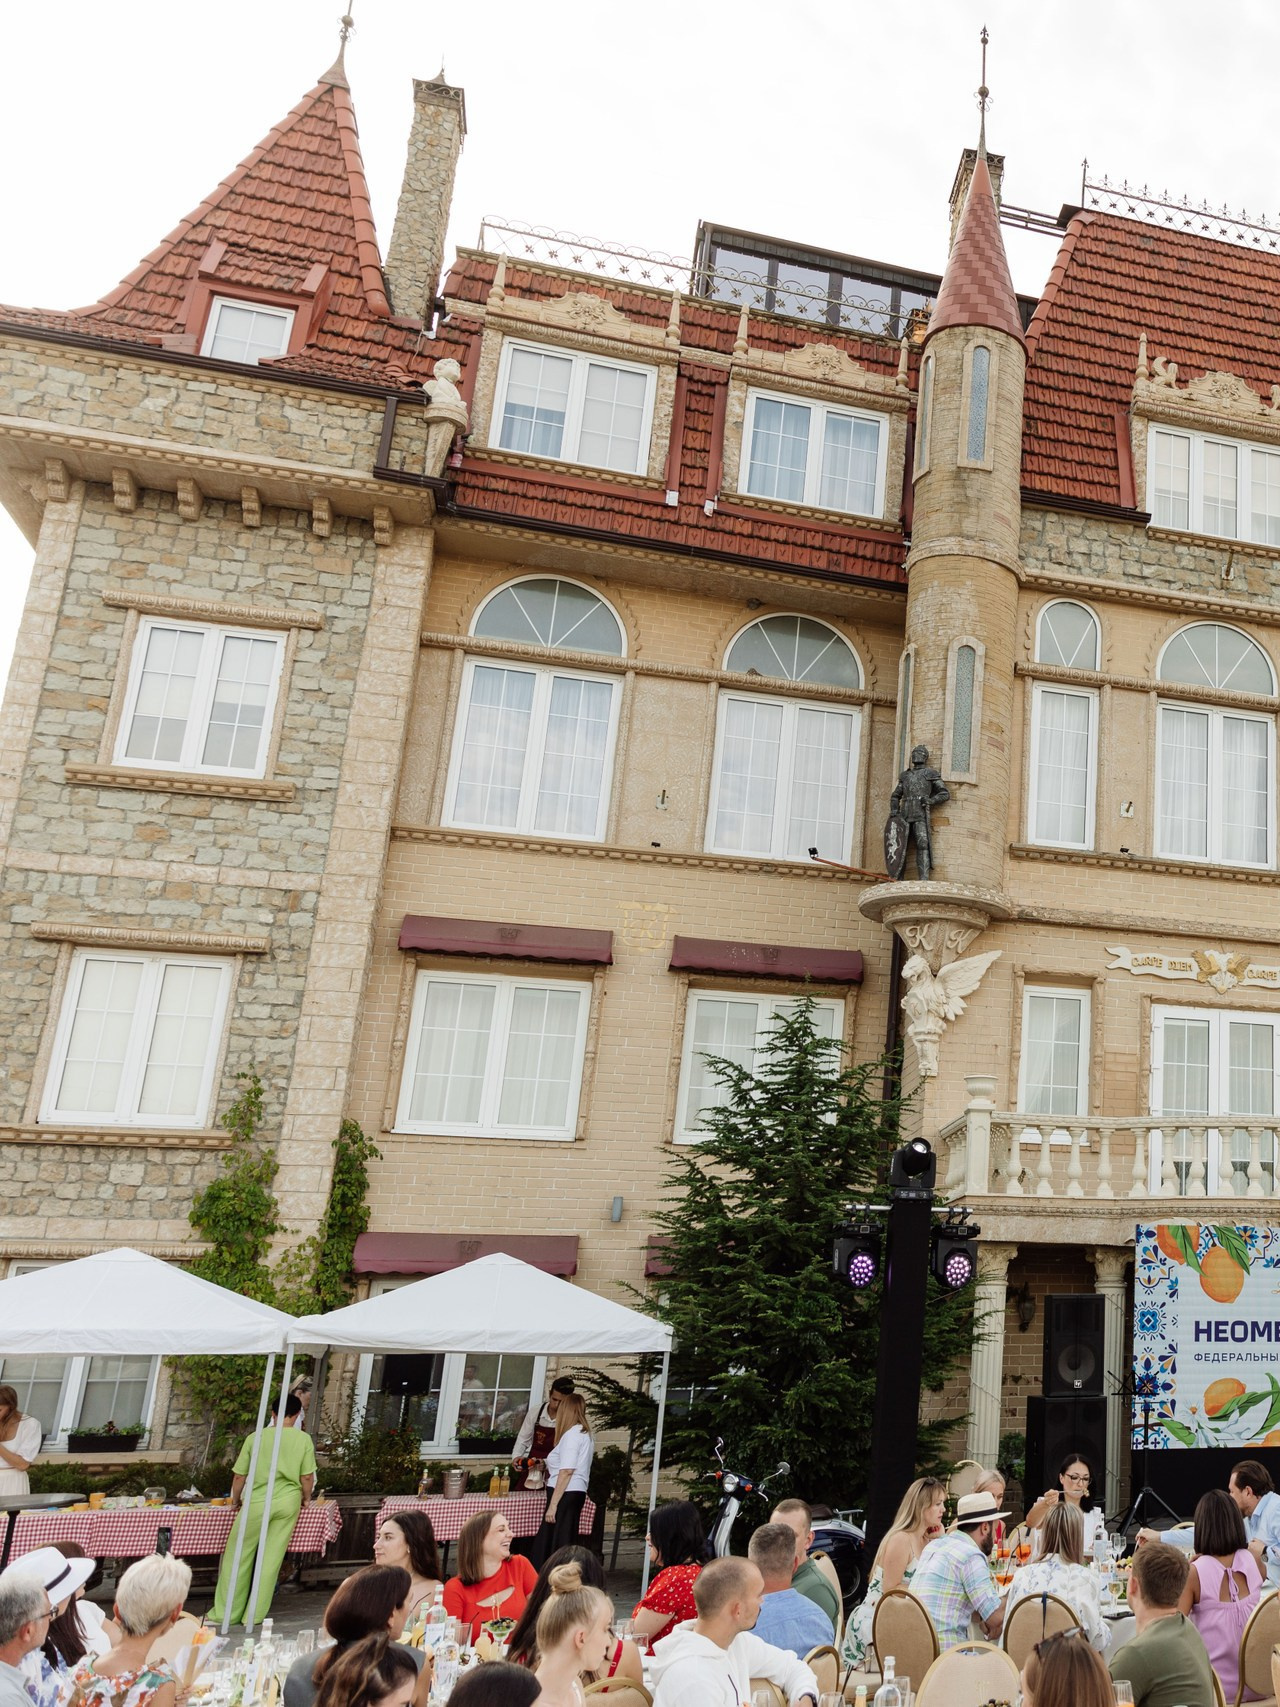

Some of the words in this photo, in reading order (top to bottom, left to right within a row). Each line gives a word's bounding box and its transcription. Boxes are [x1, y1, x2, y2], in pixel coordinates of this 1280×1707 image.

[1131, 956, 1163, 968] CARPE
[1168, 960, 1193, 972] DIEM
[1246, 969, 1278, 981] CARPE
